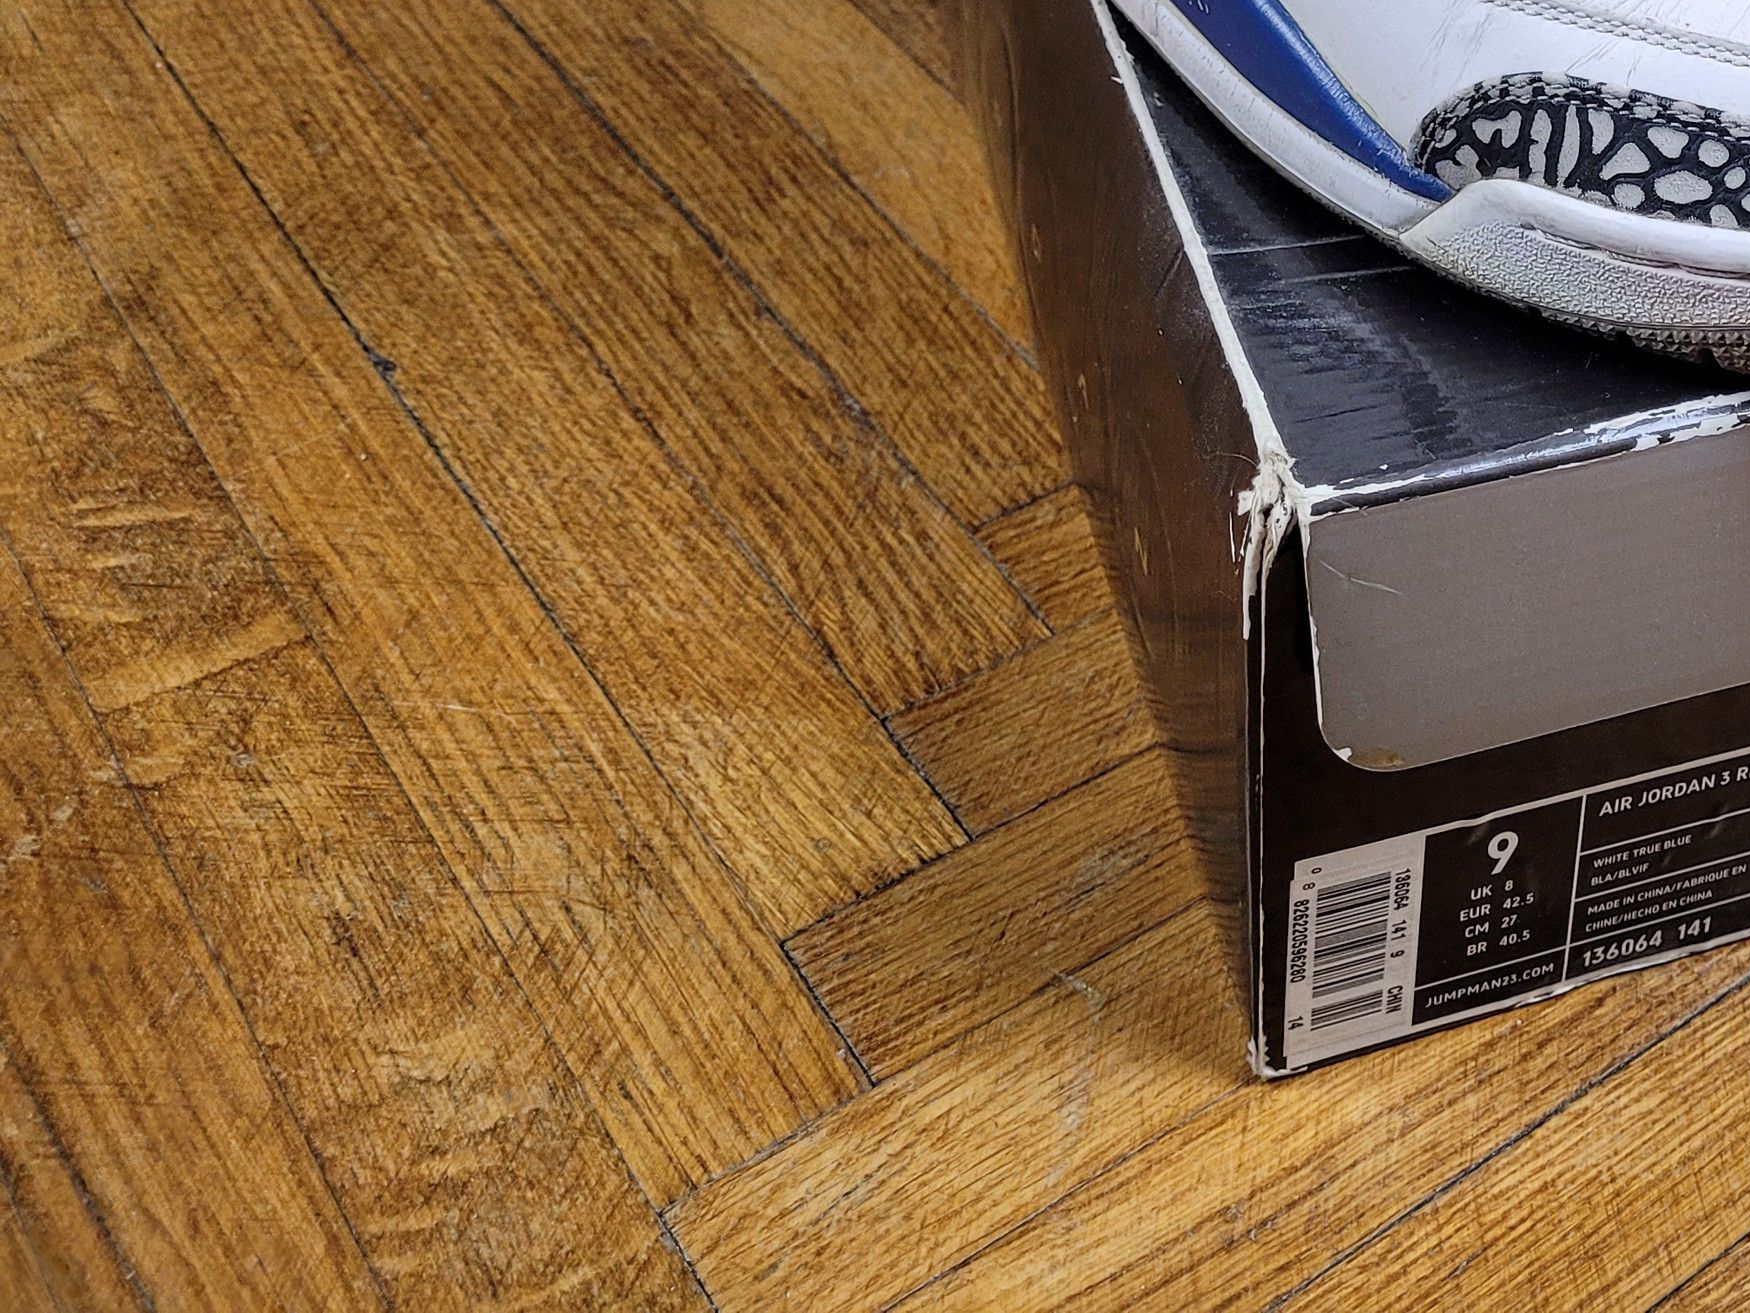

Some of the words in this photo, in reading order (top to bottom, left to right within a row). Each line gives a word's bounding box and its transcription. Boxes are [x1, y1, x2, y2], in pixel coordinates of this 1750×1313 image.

[1599, 796, 1633, 817] AIR
[1638, 774, 1716, 807] JORDAN
[1720, 771, 1731, 785] 3
[1488, 831, 1519, 875] 9
[1593, 851, 1630, 868] WHITE
[1632, 842, 1662, 858] TRUE
[1663, 834, 1692, 850] BLUE
[1393, 868, 1411, 911] 136064
[1470, 884, 1493, 901] UK
[1504, 880, 1514, 891] 8
[1587, 899, 1620, 916] MADE
[1623, 894, 1635, 906] IN
[1637, 869, 1730, 902] CHINA/FABRIQUE
[1731, 864, 1748, 877] EN
[1459, 903, 1491, 922] EUR
[1502, 893, 1534, 909] 42.5
[1585, 905, 1660, 932] CHINE/HECHO
[1662, 899, 1677, 911] EN
[1679, 890, 1713, 906] CHINA
[1391, 919, 1407, 940] 141
[1465, 922, 1490, 938] CM
[1500, 914, 1518, 929] 27
[1582, 930, 1663, 967] 136064
[1678, 916, 1712, 940] 141
[1389, 949, 1405, 958] 9
[1466, 941, 1487, 956] BR
[1499, 929, 1531, 946] 40.5
[1386, 985, 1404, 1014] CHIN
[1425, 963, 1554, 1008] JUMPMAN23.COM
[1288, 1016, 1304, 1030] 14
